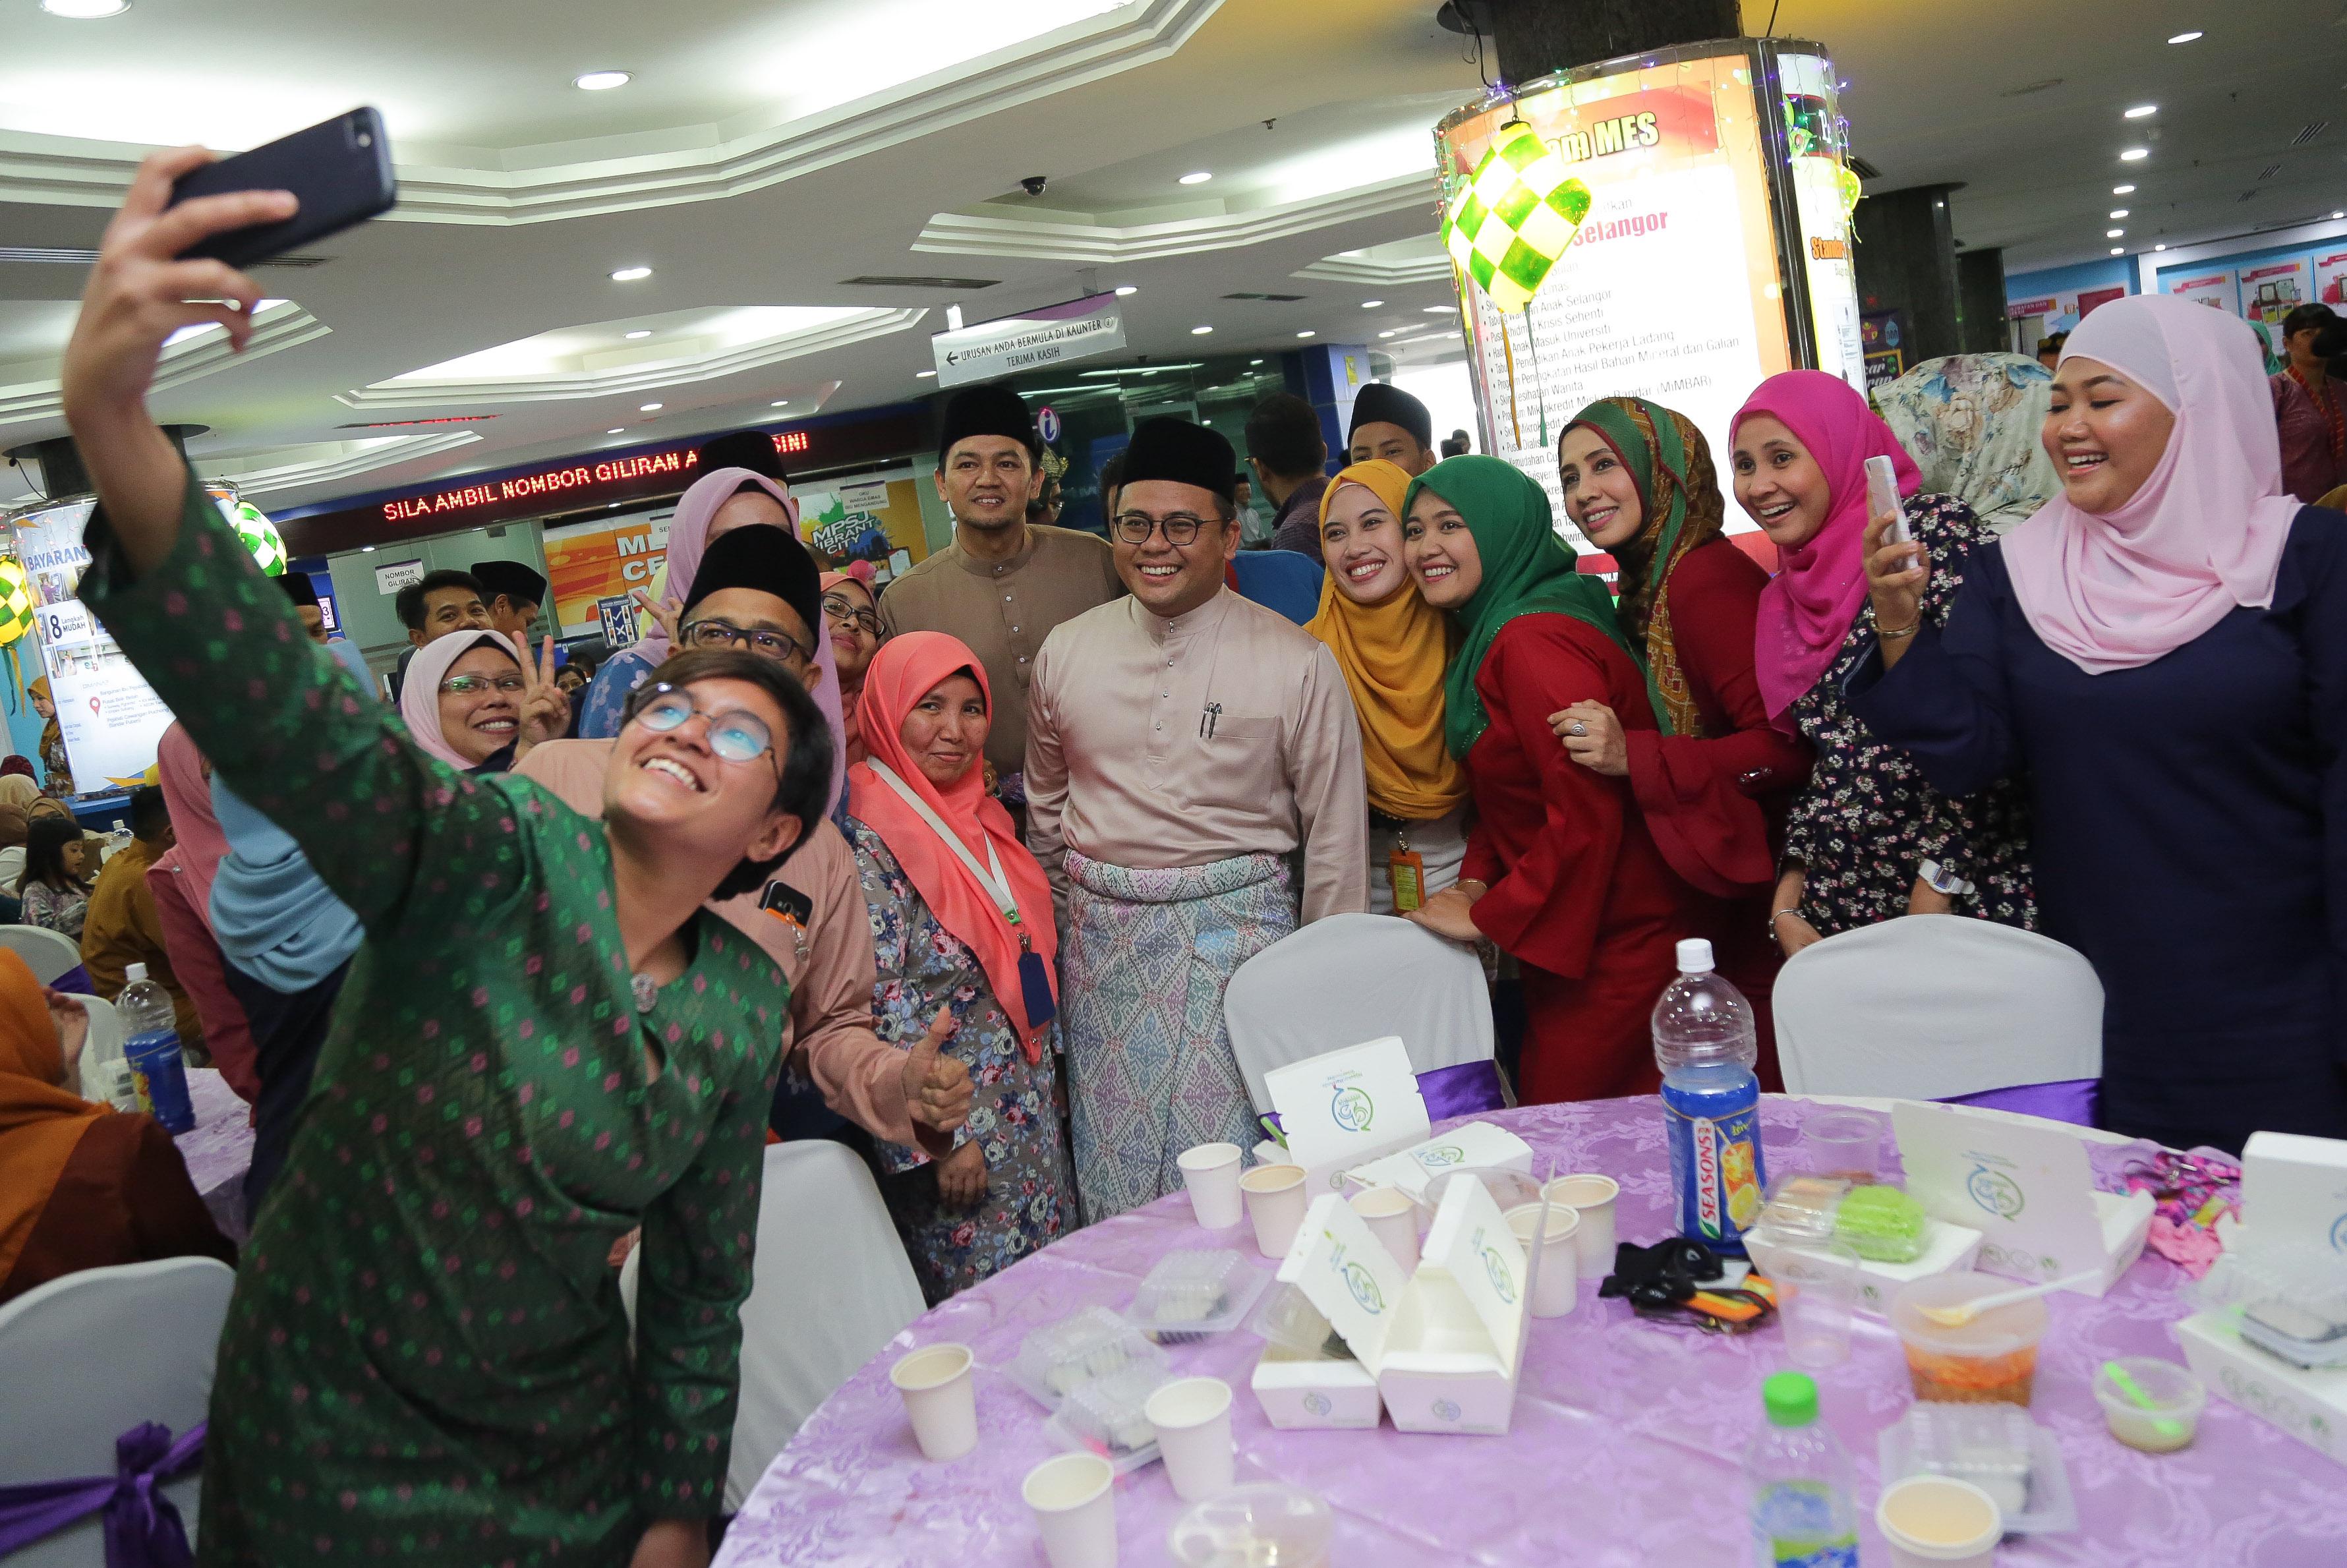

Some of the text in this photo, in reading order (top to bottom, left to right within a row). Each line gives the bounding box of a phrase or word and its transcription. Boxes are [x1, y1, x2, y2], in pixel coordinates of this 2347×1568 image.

[1593, 111, 1660, 158] MES
[1488, 314, 1508, 327] Tabug
[1541, 299, 1563, 313] Anak
[1566, 290, 1612, 307] Selangor
[1491, 332, 1503, 343] Pusa
[1538, 318, 1563, 331] Krisis
[1565, 307, 1604, 324] Sehenti
[1513, 339, 1530, 353] Anak
[1564, 324, 1611, 341] Universiti
[961, 347, 992, 361] URUSAN
[994, 342, 1016, 353] ANDA
[1018, 332, 1054, 348] BERMULA
[1056, 330, 1064, 339] DI
[1067, 320, 1102, 336] KAUNTER
[1562, 345, 1586, 359] Anak
[1589, 338, 1629, 355] Pekerja
[1633, 331, 1674, 346] Ladang
[1007, 347, 1060, 367] TERIMA KASIH
[1575, 361, 1598, 375] Hasil
[1601, 354, 1635, 370] Bahan
[1683, 343, 1703, 356] dan
[1706, 337, 1739, 351] Galian
[1551, 380, 1583, 394] Wanita
[384, 498, 431, 520] SILA
[435, 485, 498, 511] AMBIL
[502, 467, 591, 500] NOMBOR
[595, 453, 680, 482] GILIRAN
[813, 511, 869, 544] MPSJ
[827, 534, 860, 555] CITY
[385, 569, 415, 579] NOMBOR
[388, 577, 415, 587] GILIRAN
[50, 615, 63, 639] 8
[61, 615, 84, 625] Langkah
[63, 622, 86, 633] MUDAH
[1698, 1135, 1717, 1221] SEASONS
